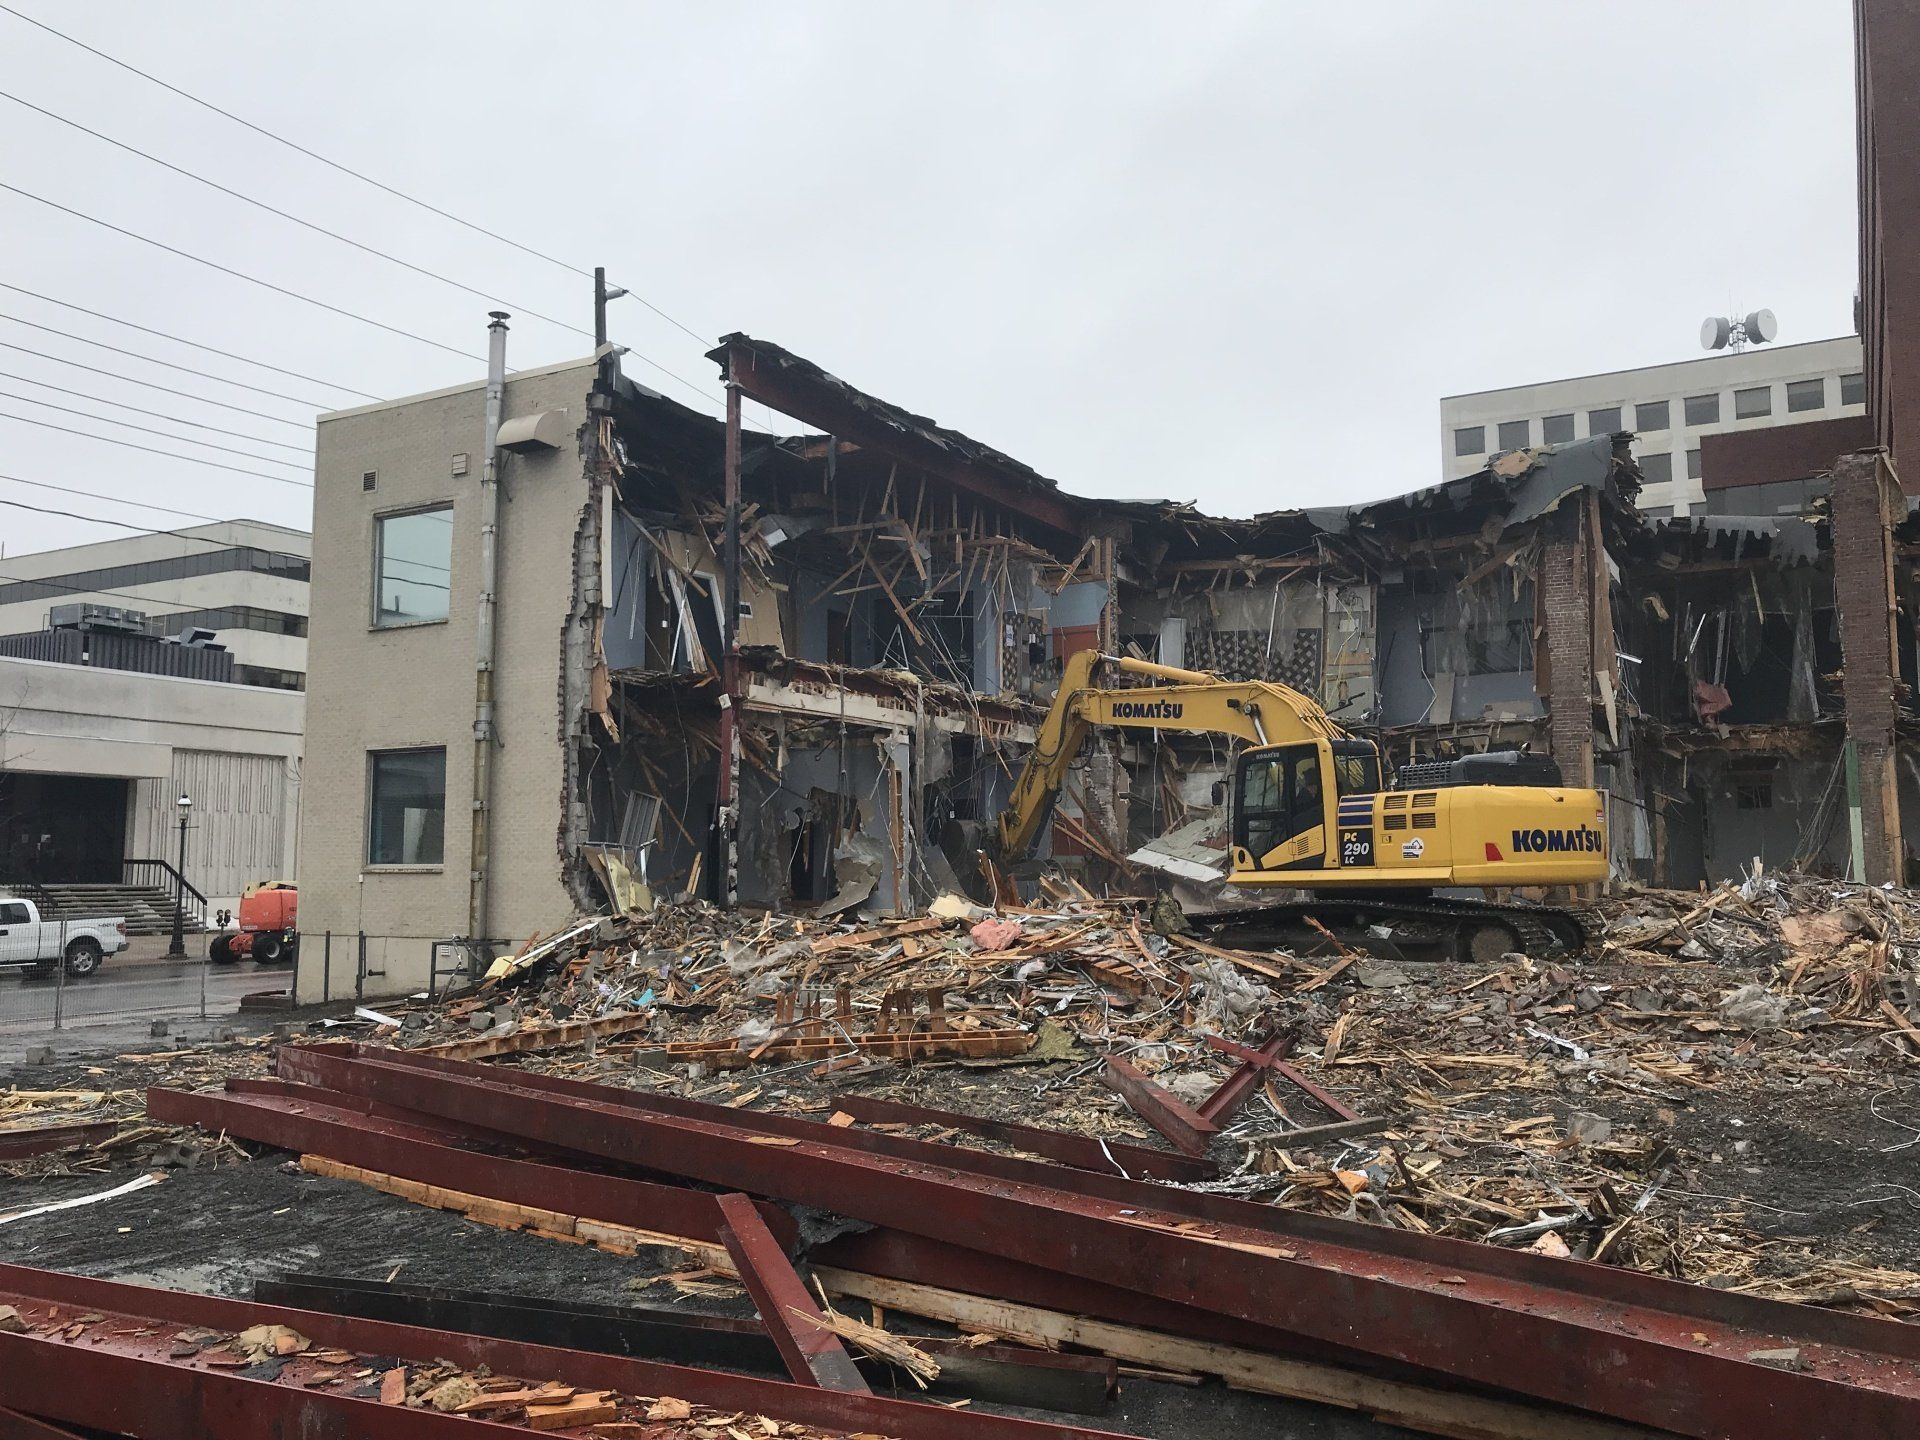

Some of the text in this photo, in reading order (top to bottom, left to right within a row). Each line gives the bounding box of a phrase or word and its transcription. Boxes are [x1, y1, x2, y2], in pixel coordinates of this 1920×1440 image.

[1113, 699, 1183, 719] KOMATSU
[1343, 832, 1358, 842] PC
[1512, 824, 1601, 852] KOMATSU
[1343, 842, 1370, 856] 290
[1344, 856, 1355, 864] LC
